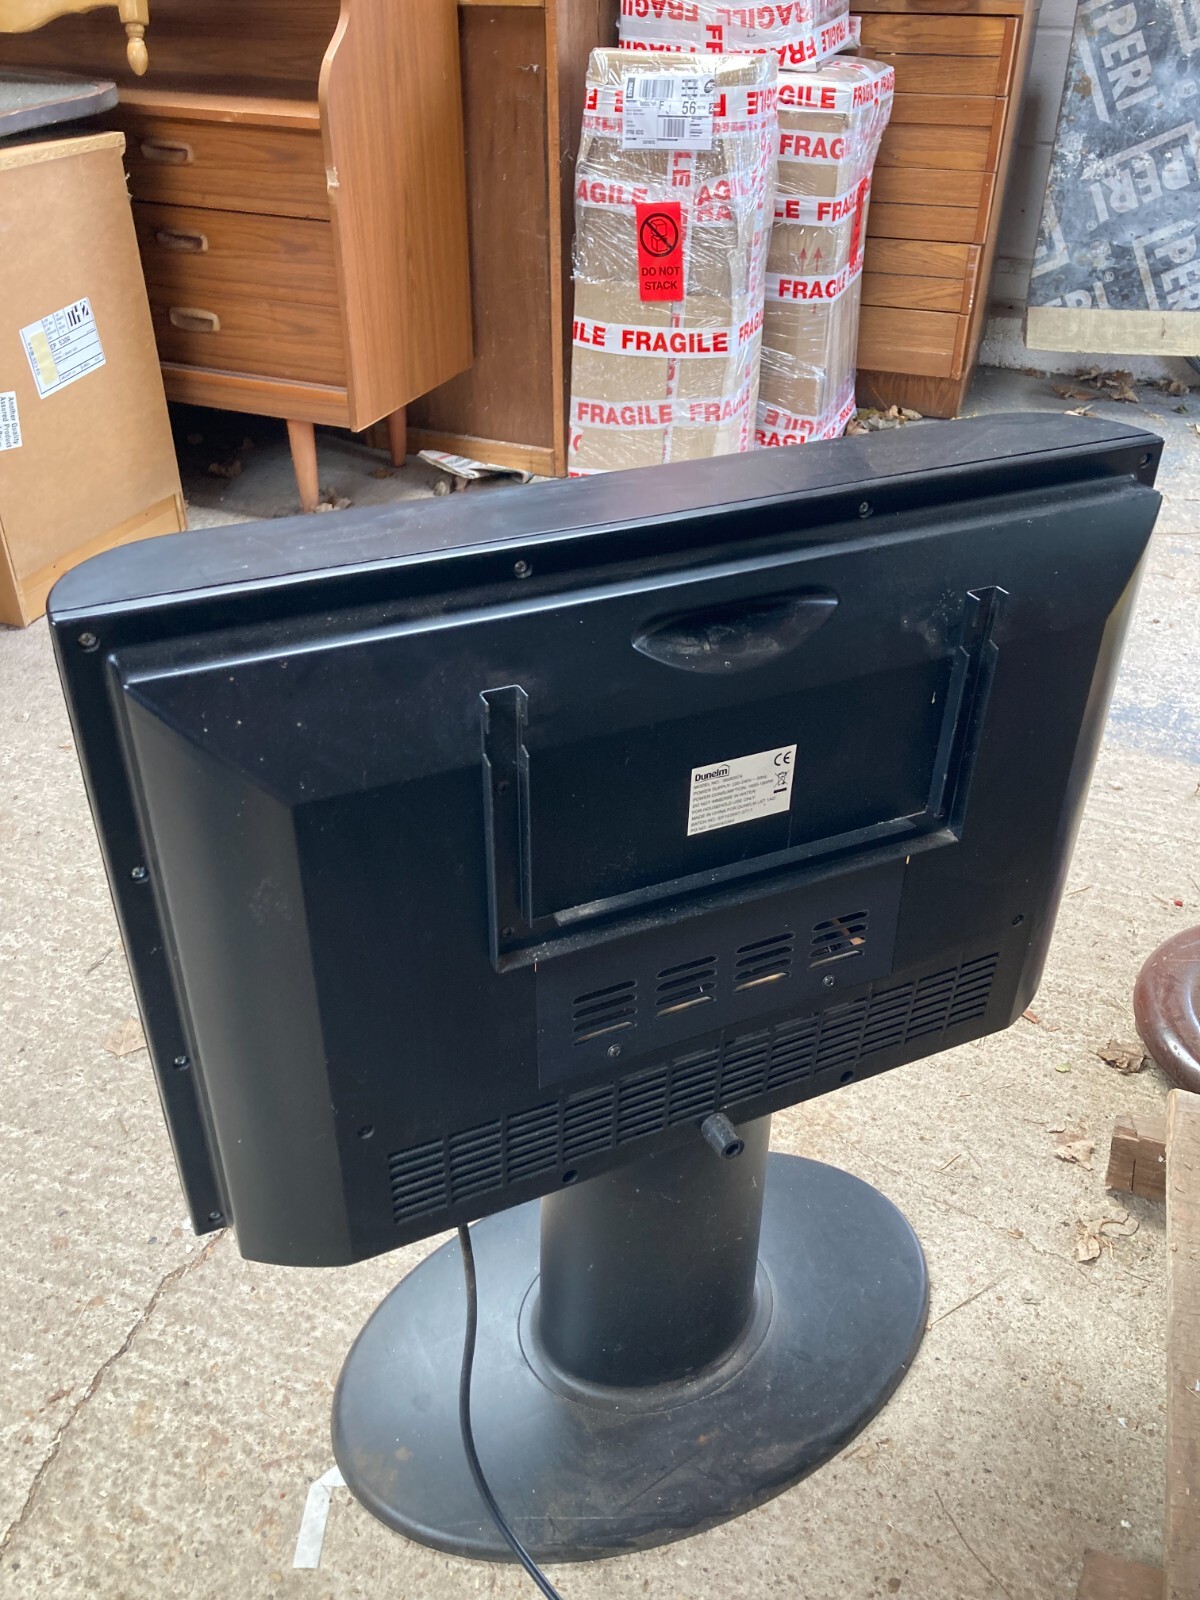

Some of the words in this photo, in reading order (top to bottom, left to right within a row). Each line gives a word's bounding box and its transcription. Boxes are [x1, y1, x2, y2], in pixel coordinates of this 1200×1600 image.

[1092, 2, 1158, 112] PERI
[681, 101, 696, 115] 56
[1089, 145, 1190, 224] PERI
[641, 266, 657, 277] DO
[658, 265, 681, 277] NOT
[644, 280, 678, 291] STACK
[621, 329, 728, 353] FRAGILE
[0, 396, 9, 422] Assured
[8, 396, 16, 421] Another
[577, 402, 673, 426] FRAGILE
[3, 423, 12, 448] Product
[11, 422, 20, 445] Quality
[695, 768, 728, 782] Dunelm
[692, 794, 710, 802] POWER
[693, 787, 711, 796] POWER
